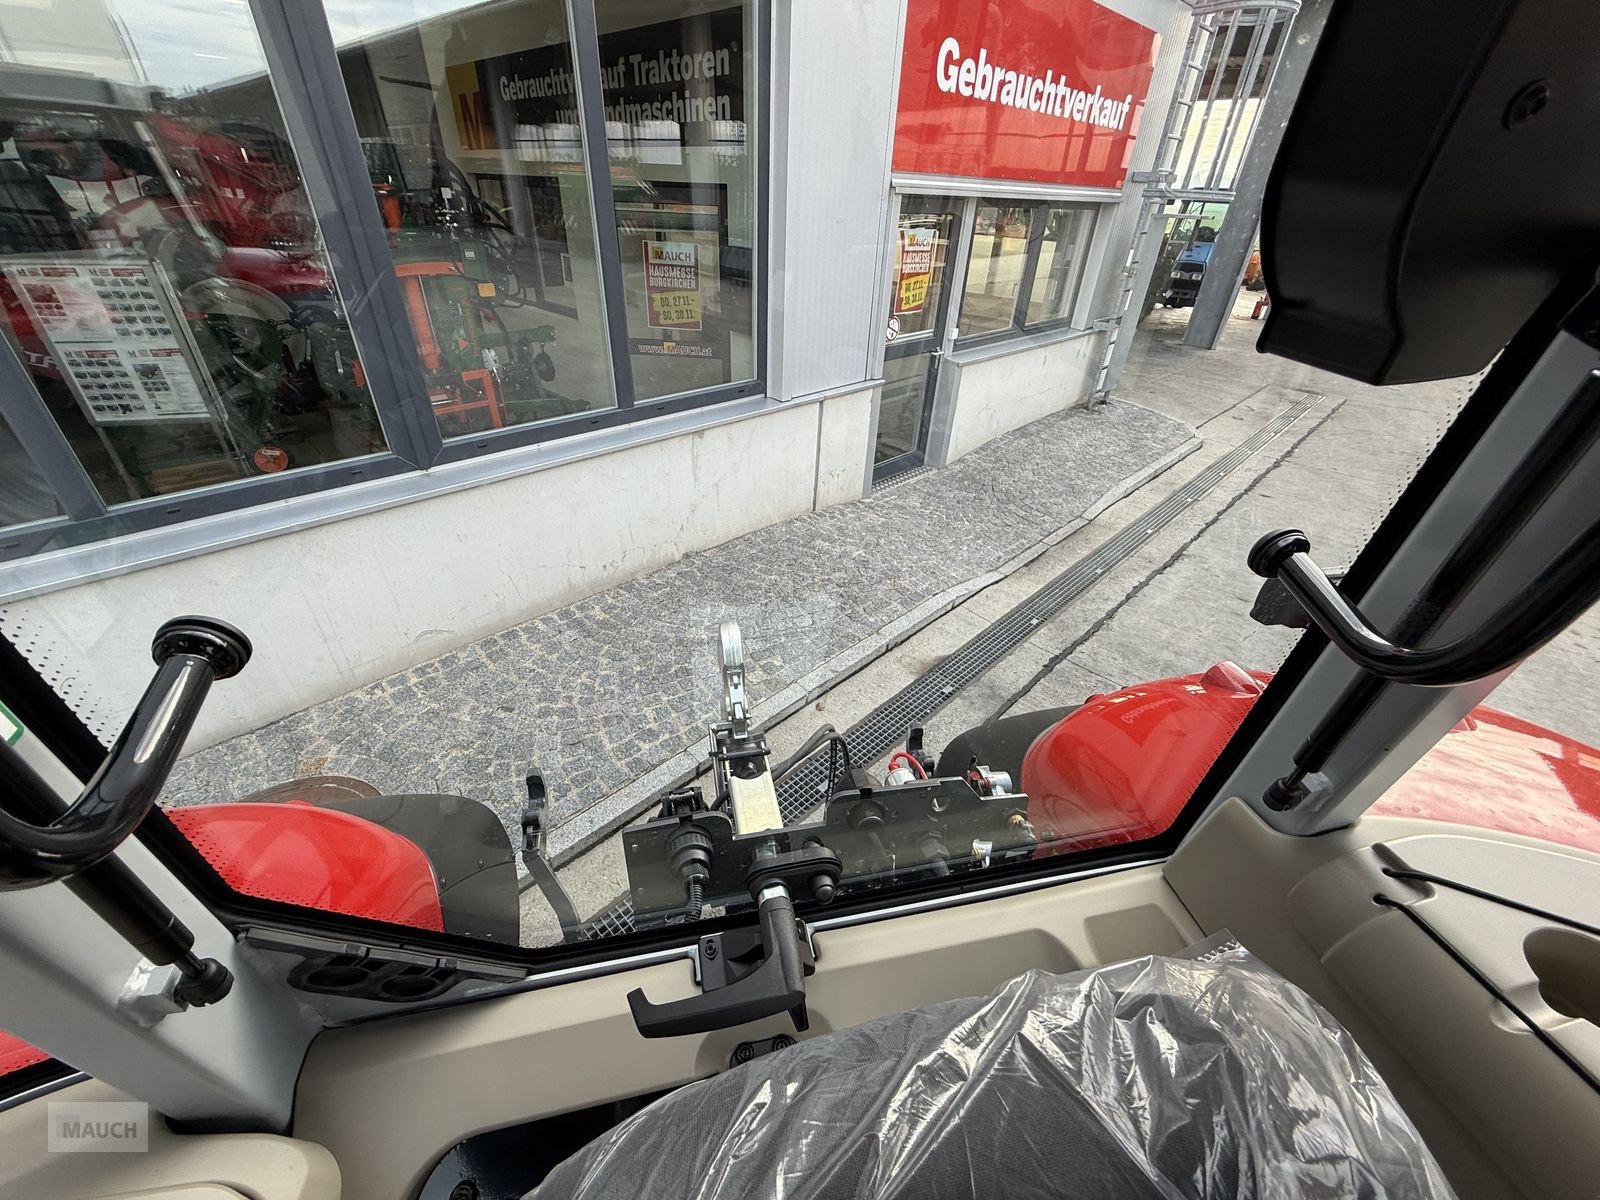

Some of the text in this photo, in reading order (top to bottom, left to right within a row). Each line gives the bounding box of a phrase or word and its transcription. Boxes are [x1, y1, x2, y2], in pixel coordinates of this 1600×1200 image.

[500, 48, 730, 101] Gebrauchtvauf Traktoren
[936, 36, 1133, 130] Gebrauchtverkauf
[604, 91, 731, 125] ndmaschinen
[654, 250, 691, 262] MAUCH
[648, 265, 696, 279] HAUSMESSE
[649, 276, 696, 289] BURGKIRCHEN
